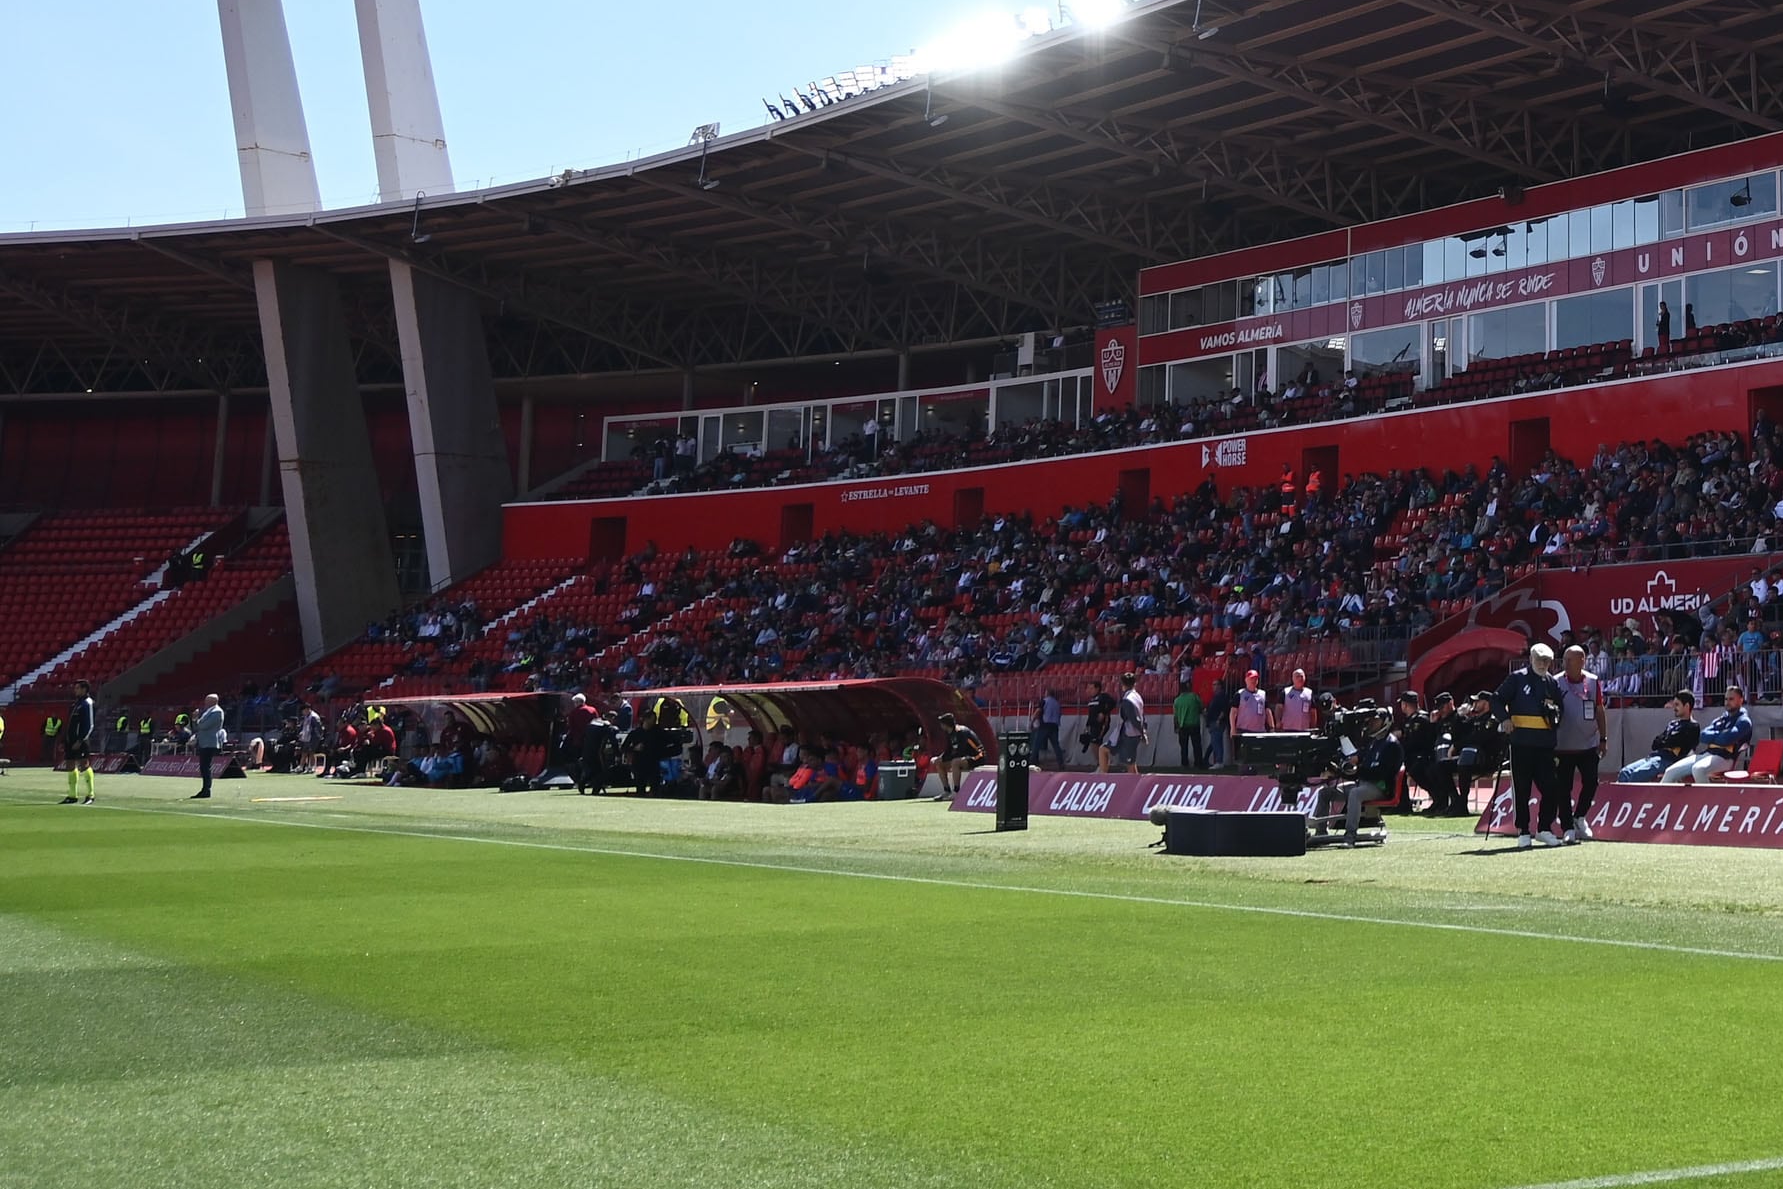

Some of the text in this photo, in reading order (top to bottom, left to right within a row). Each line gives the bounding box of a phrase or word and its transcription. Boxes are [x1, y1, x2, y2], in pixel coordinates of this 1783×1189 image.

[1638, 228, 1783, 273] UNIÓN
[1404, 273, 1556, 319] ALMERÍA NUNCA SE RINDE
[1200, 322, 1283, 351] VAMOS ALMERÍA
[1222, 439, 1246, 453] POWER
[1223, 452, 1246, 466] HORSE
[848, 488, 888, 500] ESTRELLA
[894, 484, 930, 497] LEVANTE
[1611, 587, 1711, 614] UD ALMERÍA
[1050, 781, 1116, 812] LALIGA
[1143, 784, 1214, 814] LALIGA
